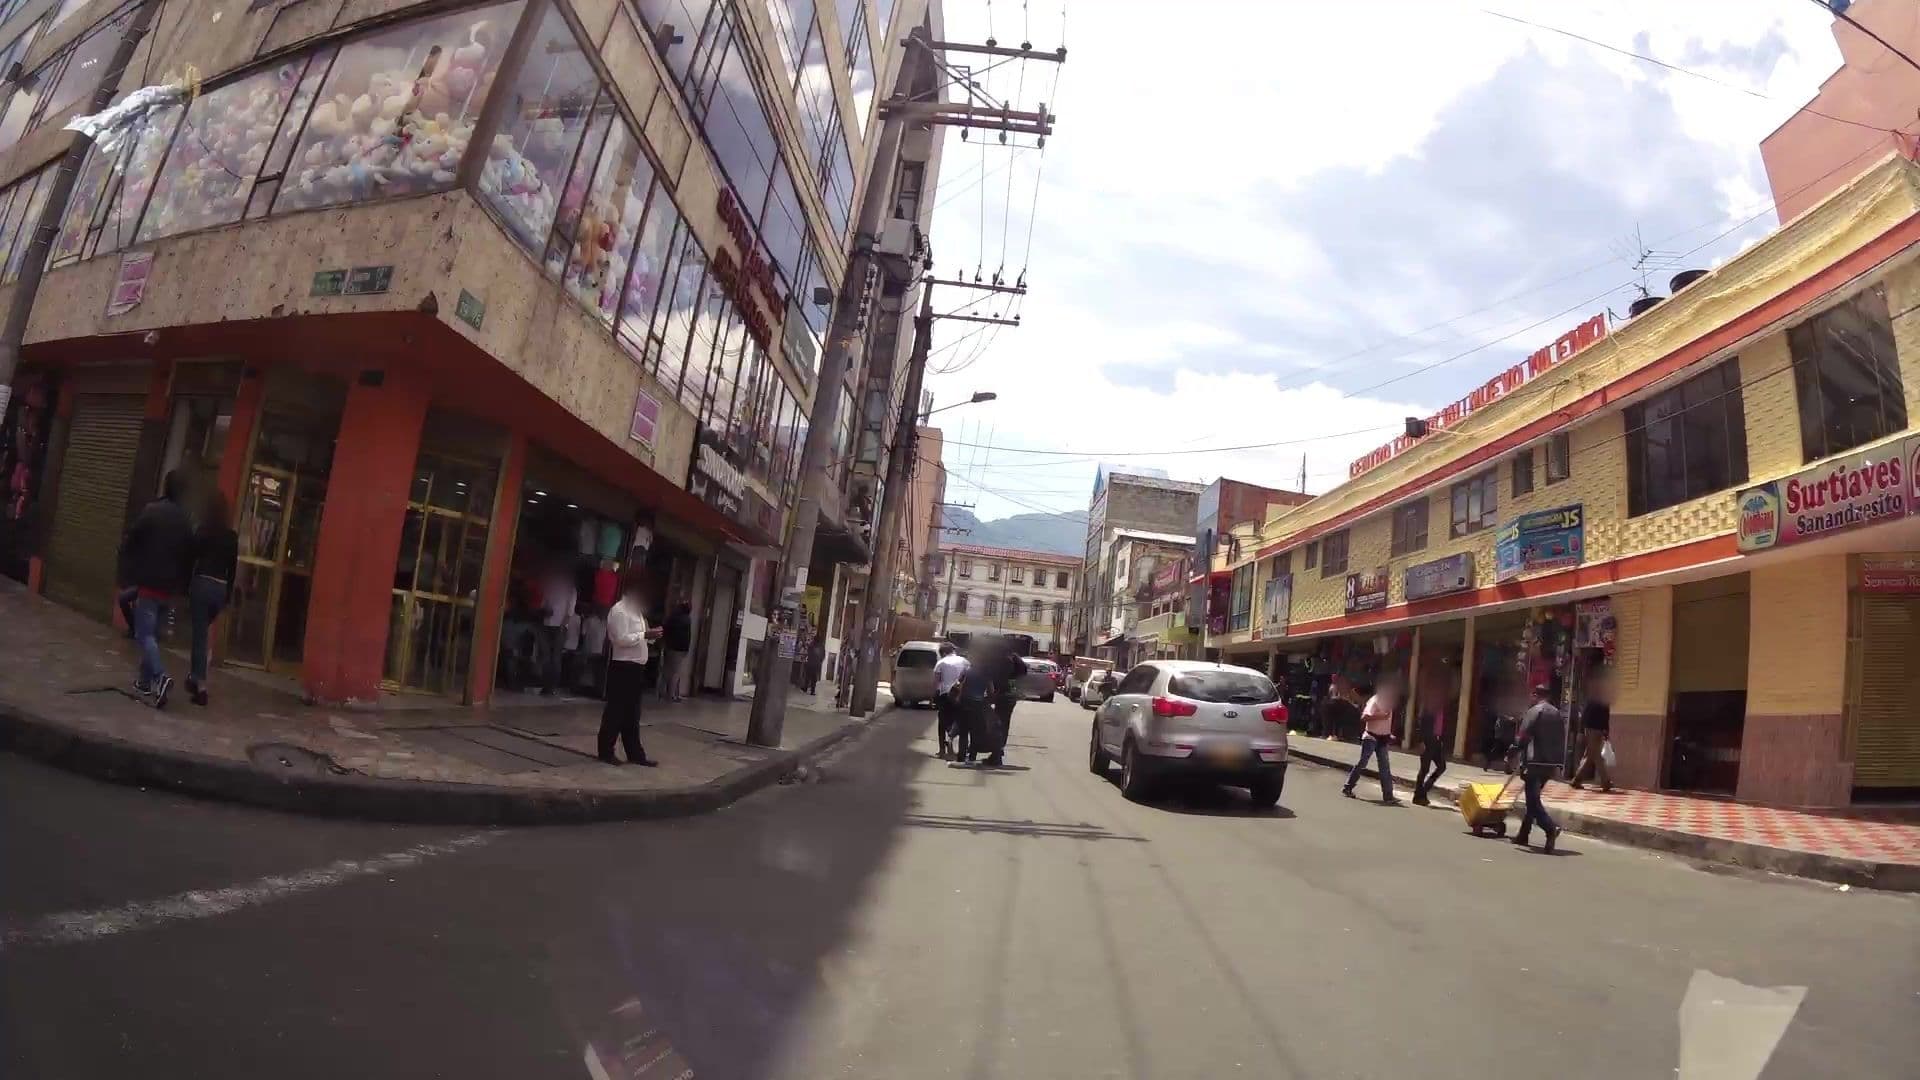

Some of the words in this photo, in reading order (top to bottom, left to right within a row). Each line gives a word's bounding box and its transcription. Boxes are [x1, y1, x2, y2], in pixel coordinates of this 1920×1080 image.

[1470, 364, 1523, 408] NUEVO
[1786, 456, 1900, 514] Surtiaves
[1797, 493, 1902, 535] Sanandresito
